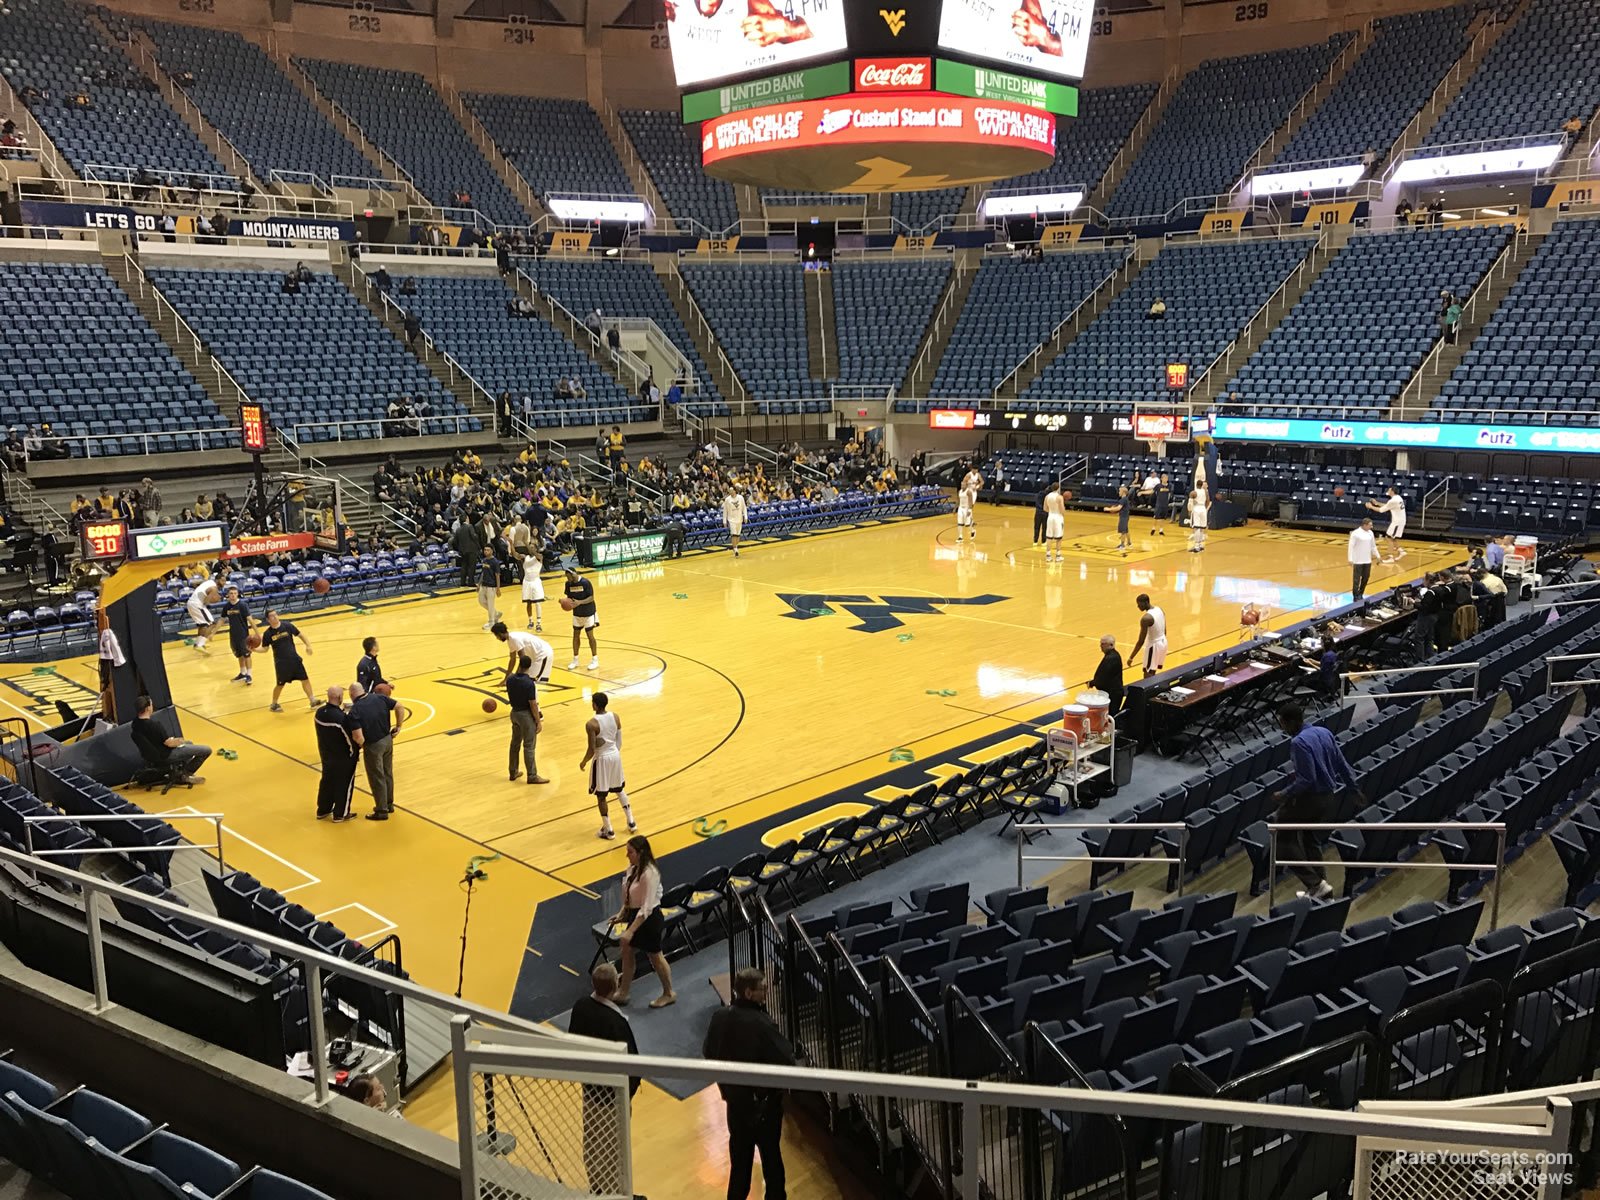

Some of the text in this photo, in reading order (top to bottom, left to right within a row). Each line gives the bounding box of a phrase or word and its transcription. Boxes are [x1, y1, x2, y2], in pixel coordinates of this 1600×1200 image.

[1235, 3, 1268, 21] 239
[1061, 12, 1081, 39] PM
[731, 73, 805, 101] UNITED BANK
[985, 71, 1047, 98] UNITED BANK
[853, 108, 899, 127] Custard
[901, 108, 936, 126] Stand
[974, 107, 1022, 123] OFFICIAL
[1568, 188, 1592, 204] 101
[85, 211, 155, 231] LET'S GO
[1320, 210, 1339, 225] 101
[242, 221, 340, 240] MOUNTAINEERS
[1052, 231, 1071, 244] 127
[1169, 373, 1185, 386] 30
[1034, 414, 1067, 426] 60:00
[94, 538, 117, 554] 30
[605, 537, 664, 553] UNITED BANK
